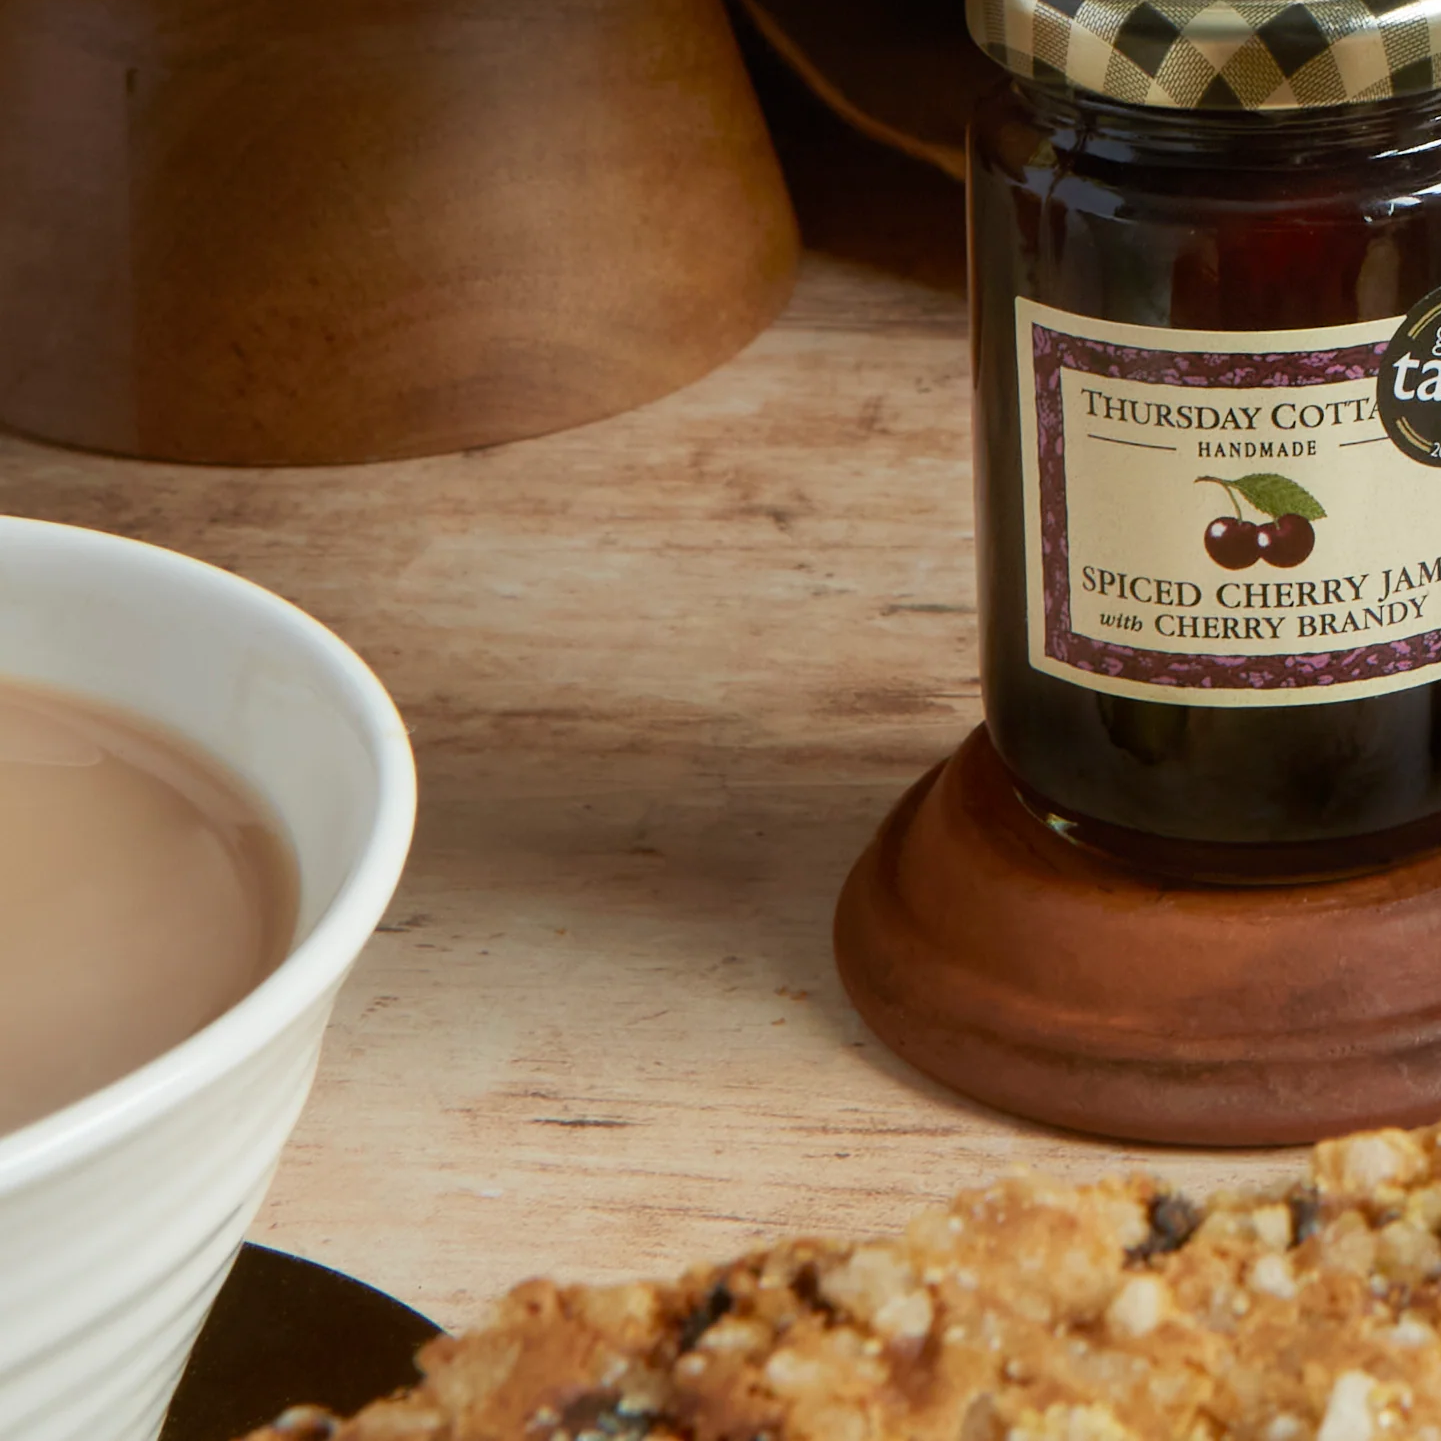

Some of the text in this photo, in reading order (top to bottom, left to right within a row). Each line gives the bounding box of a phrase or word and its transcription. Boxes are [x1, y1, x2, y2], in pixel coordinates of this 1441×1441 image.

[1081, 389, 1262, 430] THURSDAY
[1198, 440, 1317, 458] HANDMADE
[1082, 565, 1202, 609] SPICED
[1215, 574, 1369, 609] CHERRY
[1100, 594, 1428, 640] with CHERRY BRANDY
